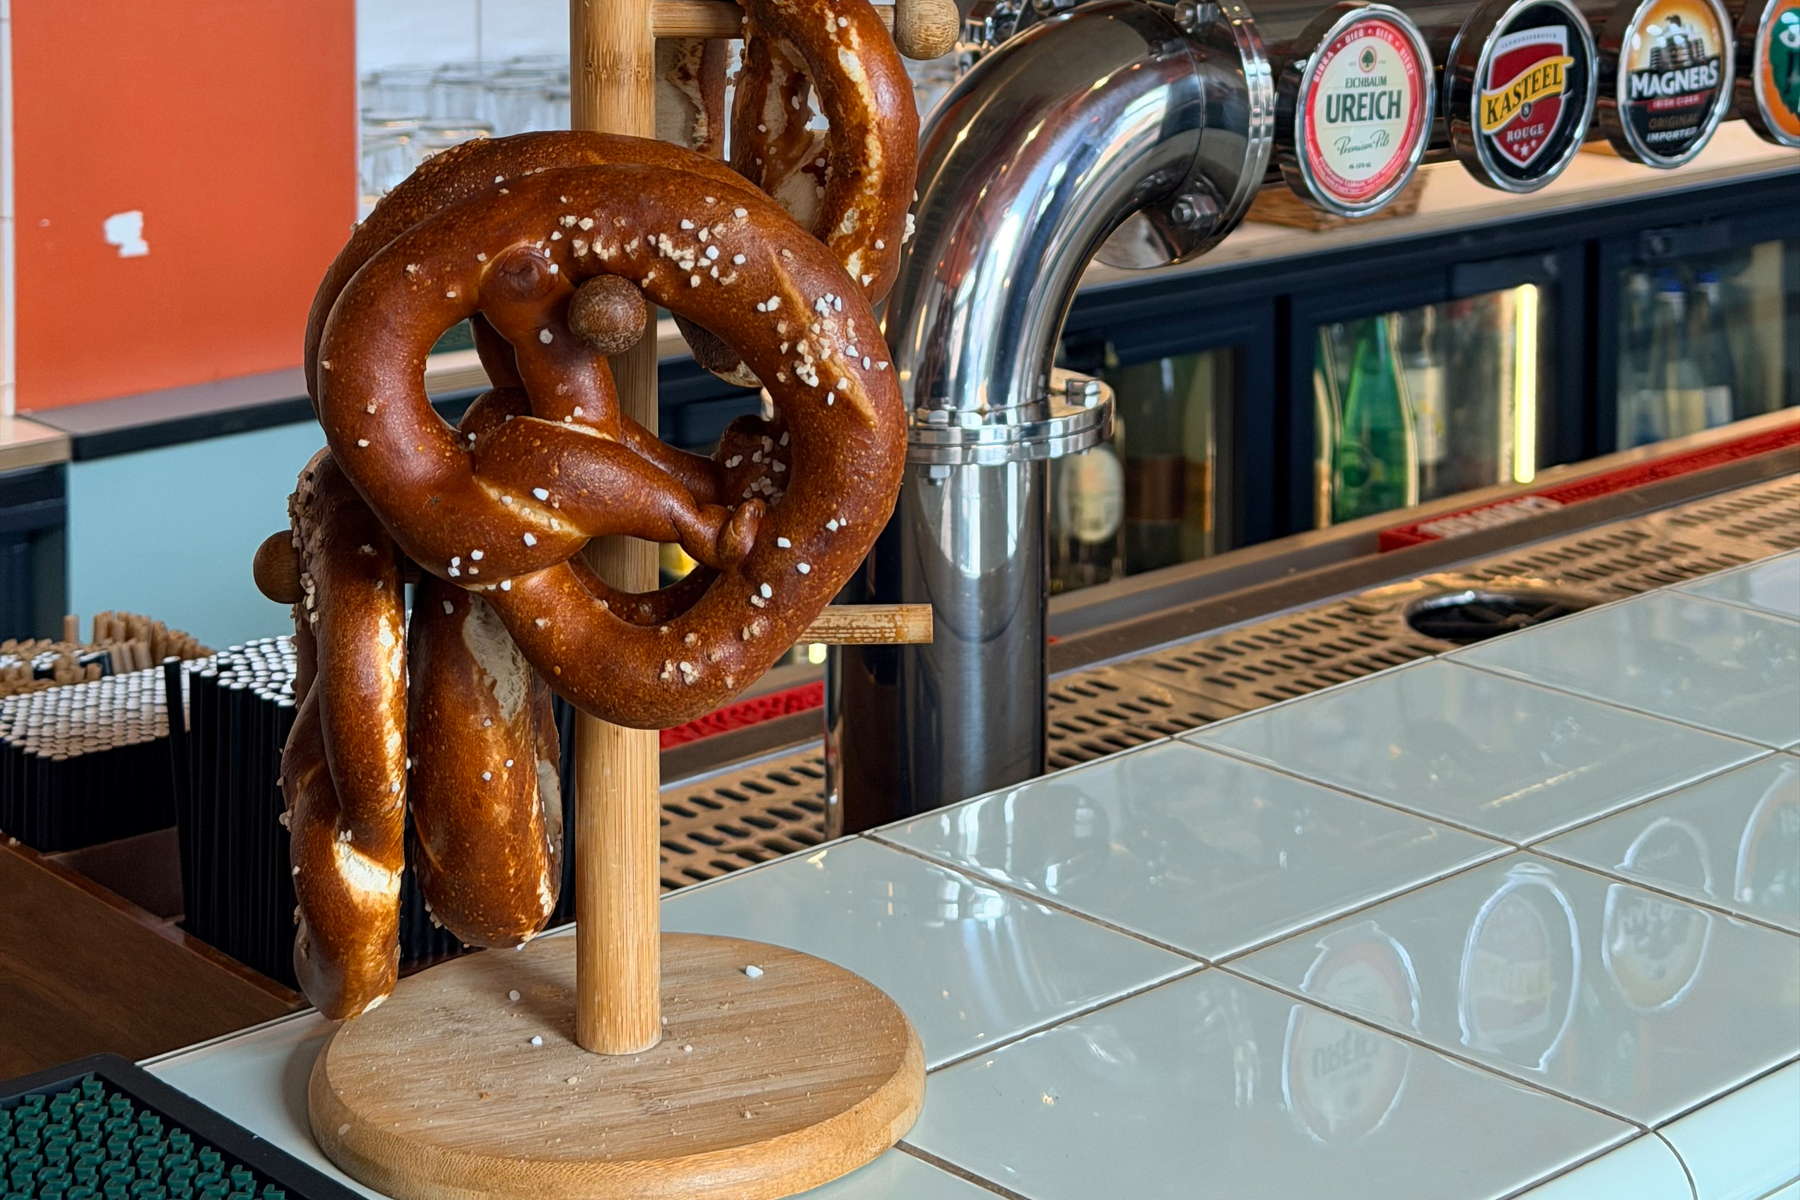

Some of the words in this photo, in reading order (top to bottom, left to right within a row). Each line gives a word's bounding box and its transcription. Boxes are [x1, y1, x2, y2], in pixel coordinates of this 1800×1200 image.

[1345, 75, 1387, 89] EICHBAUM
[1631, 60, 1719, 99] MAGNERS
[1486, 63, 1563, 125] KASTEEL
[1325, 89, 1403, 124] UREICH
[1506, 123, 1545, 142] ROUGE
[1647, 127, 1698, 142] IMPORTED
[1333, 135, 1373, 156] Premium
